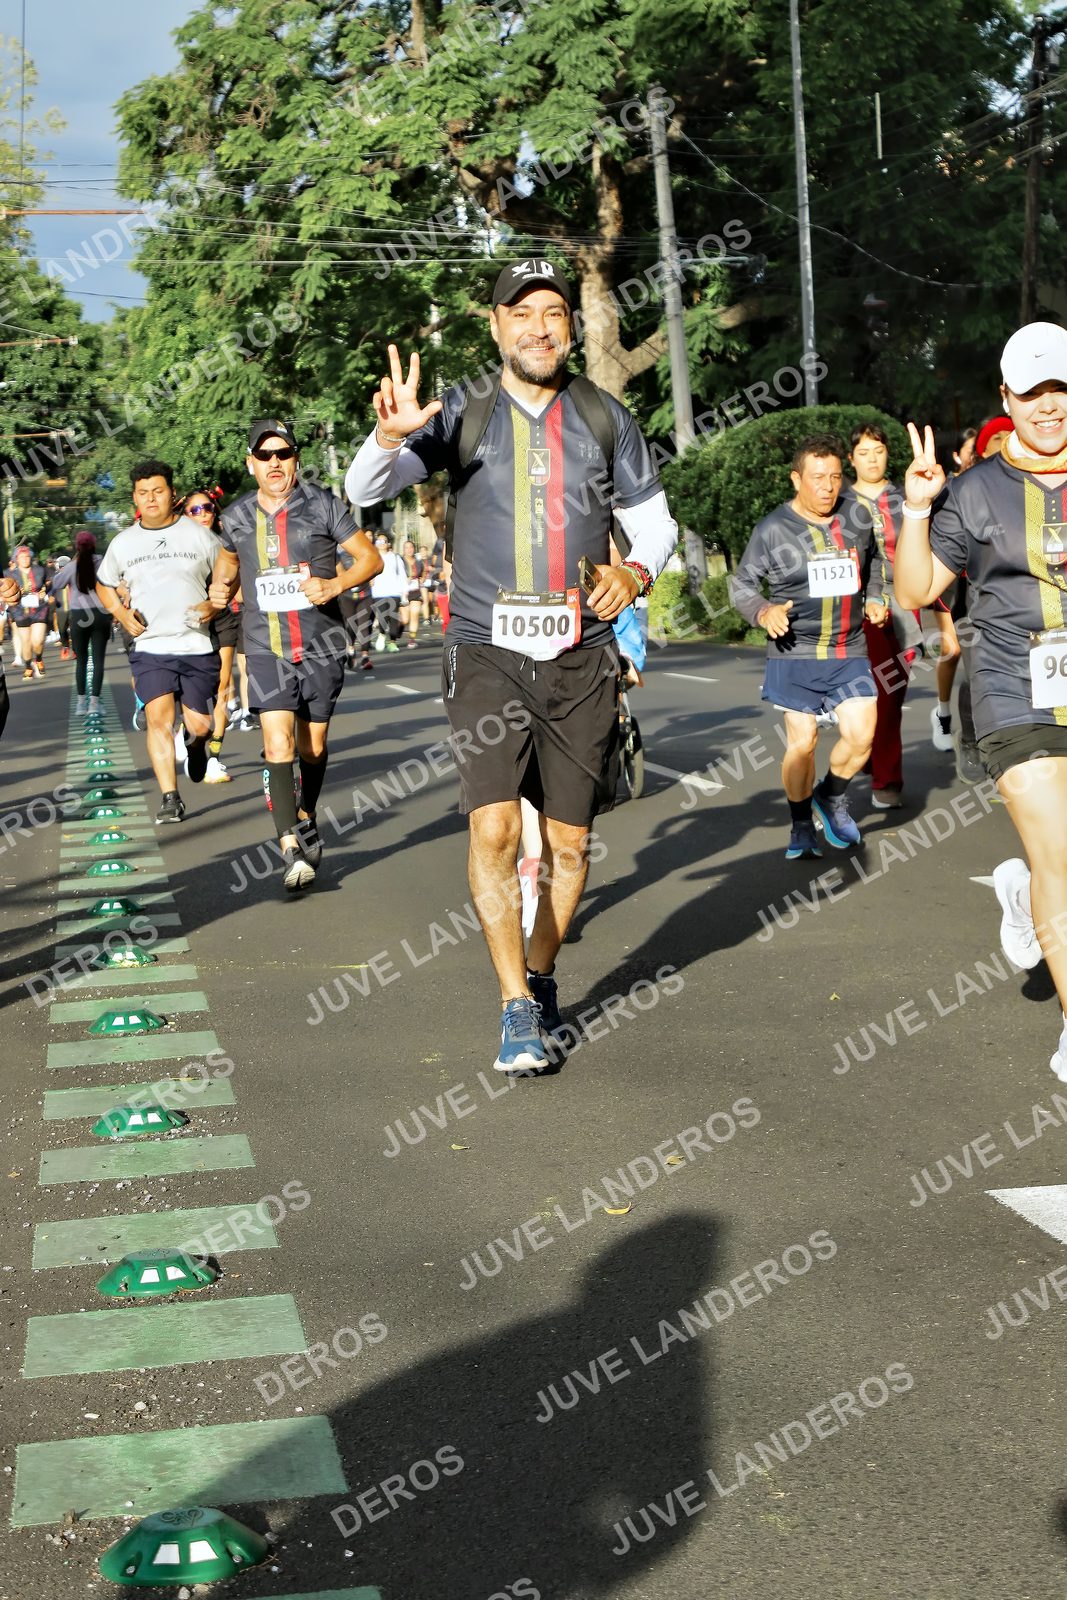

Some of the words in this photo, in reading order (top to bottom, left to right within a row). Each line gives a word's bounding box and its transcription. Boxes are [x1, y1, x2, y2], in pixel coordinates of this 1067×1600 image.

[812, 564, 853, 581] 11521
[498, 614, 570, 637] 10500
[1043, 655, 1067, 680] 96
